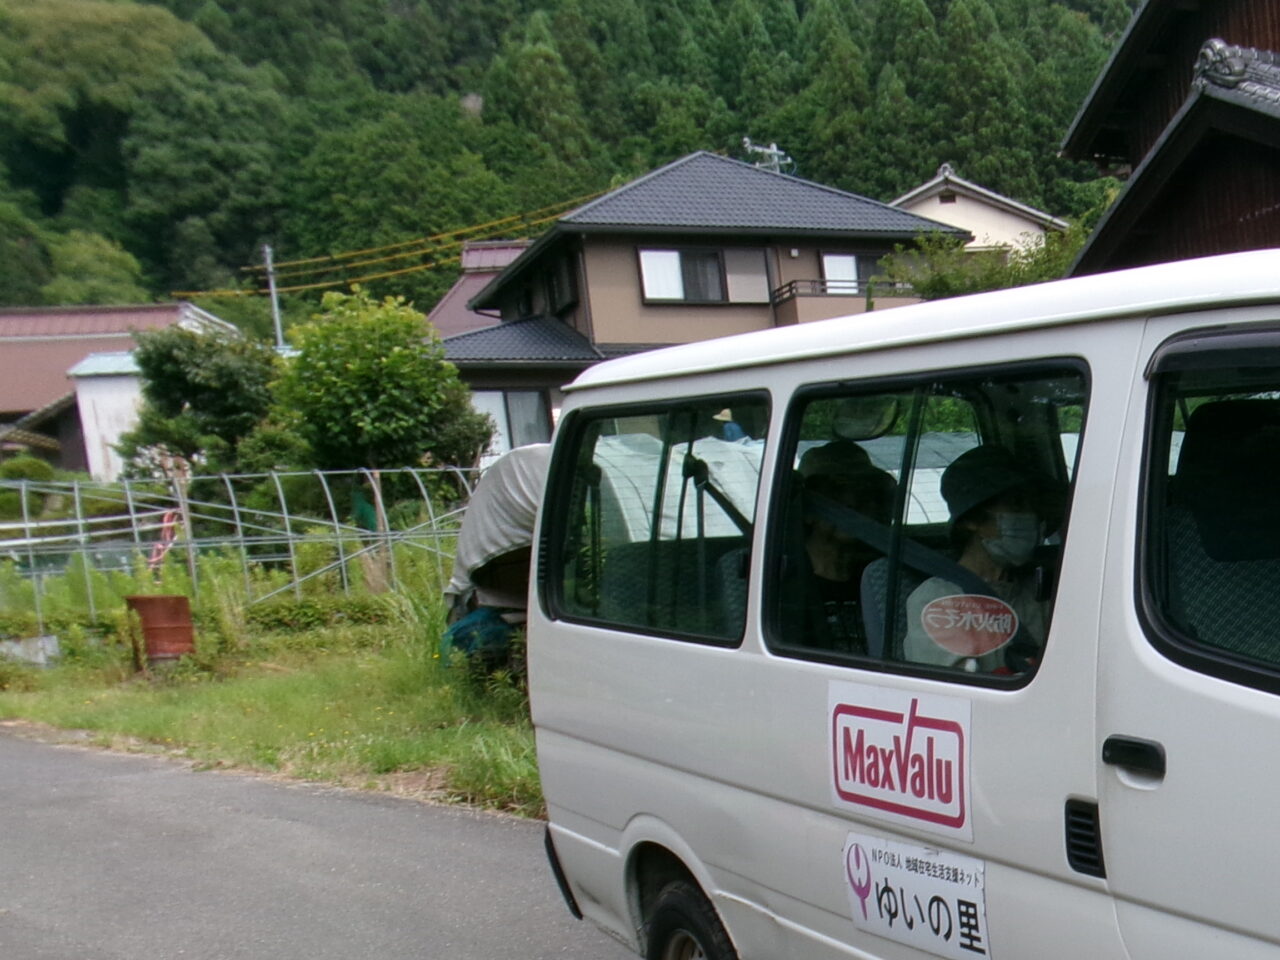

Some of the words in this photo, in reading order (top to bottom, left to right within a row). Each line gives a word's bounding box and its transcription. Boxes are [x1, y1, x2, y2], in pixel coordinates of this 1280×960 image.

[842, 698, 952, 804] MaxValu
[875, 877, 986, 955] ゆいの里
